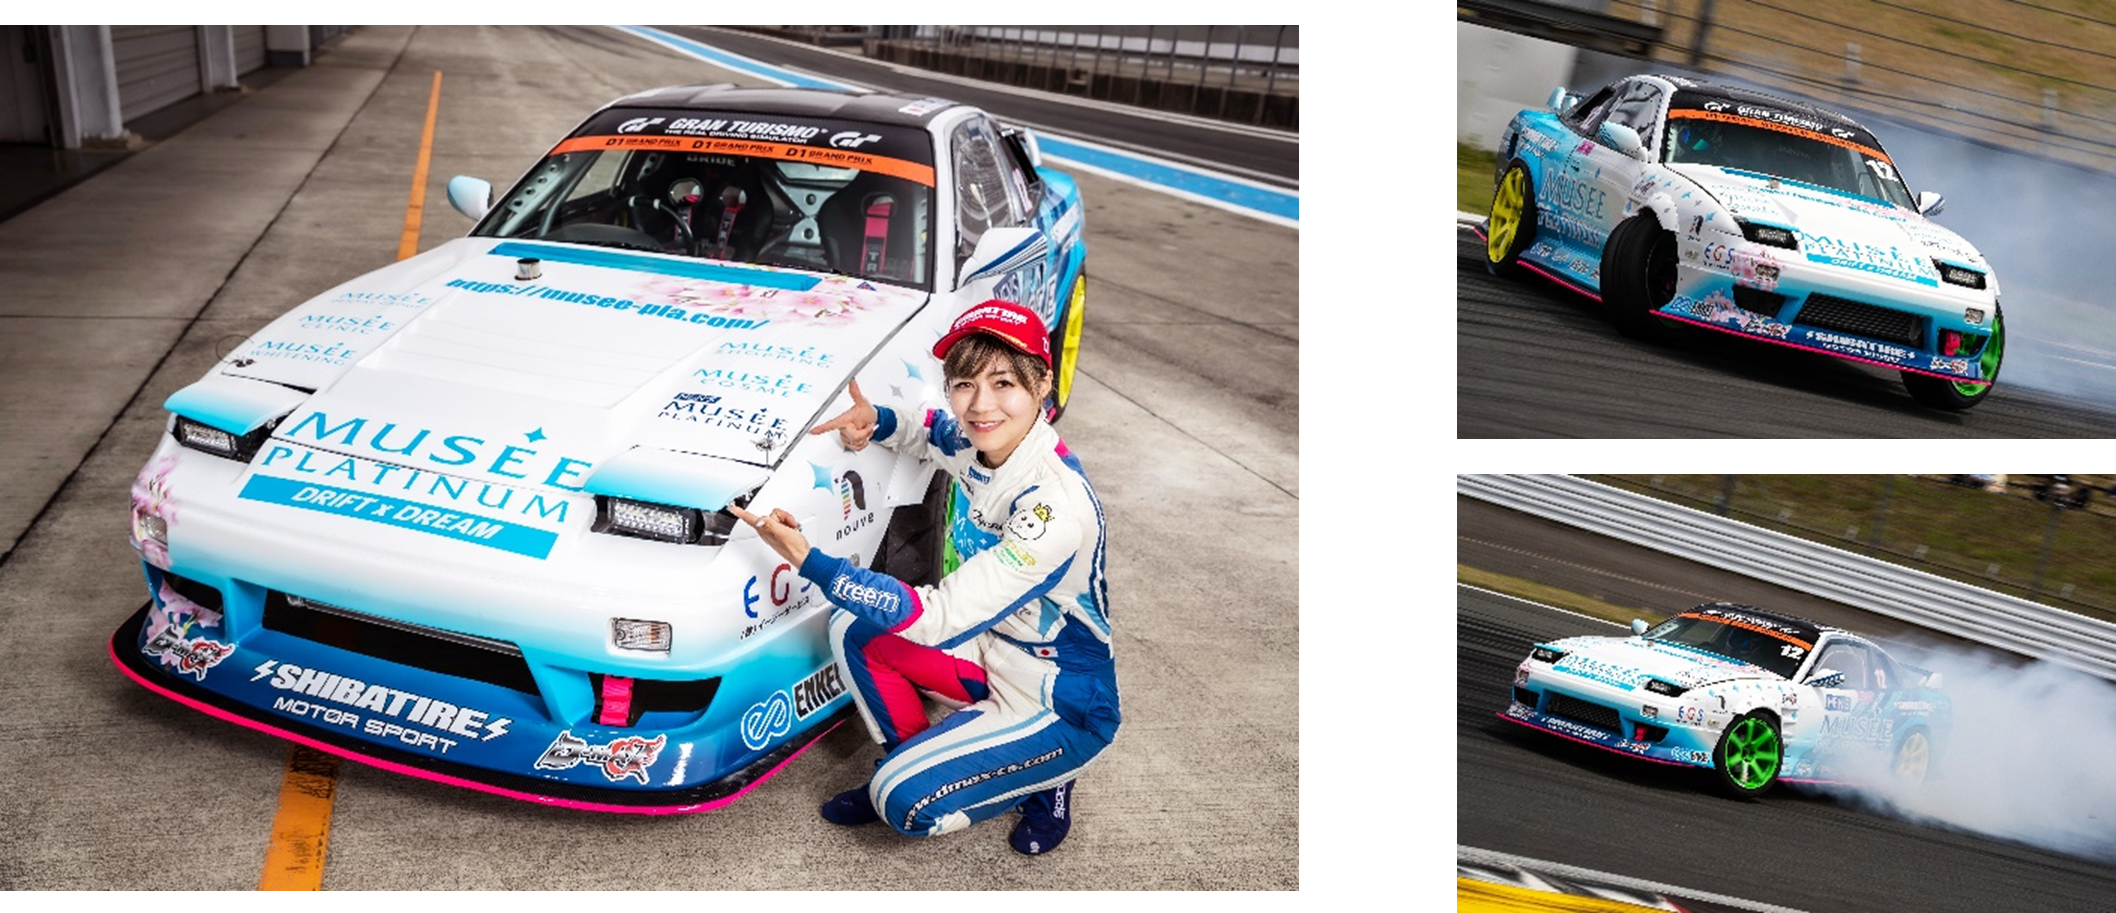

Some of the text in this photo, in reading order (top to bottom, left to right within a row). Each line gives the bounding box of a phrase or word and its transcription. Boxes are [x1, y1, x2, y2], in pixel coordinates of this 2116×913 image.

[668, 117, 728, 131] GRAN
[605, 138, 624, 146] D1
[692, 140, 775, 152] D1 GRAND PRIX
[750, 134, 808, 143] SIMULATOR
[786, 147, 873, 165] D1 GRAND PRIX
[1866, 159, 1898, 181] 12
[444, 278, 770, 330] https://musee-pla.com/
[250, 350, 345, 366] WHITENING
[700, 379, 793, 397] COSME
[284, 411, 593, 492] MUSÉE
[261, 446, 570, 523] PLATINUM
[291, 486, 373, 512] DRIFT
[393, 505, 504, 540] DREAM
[836, 512, 875, 541] nouve
[832, 574, 901, 613] freem
[1781, 645, 1805, 660] 12
[269, 662, 491, 740] SHIBATIRE
[364, 719, 457, 754] SPORT
